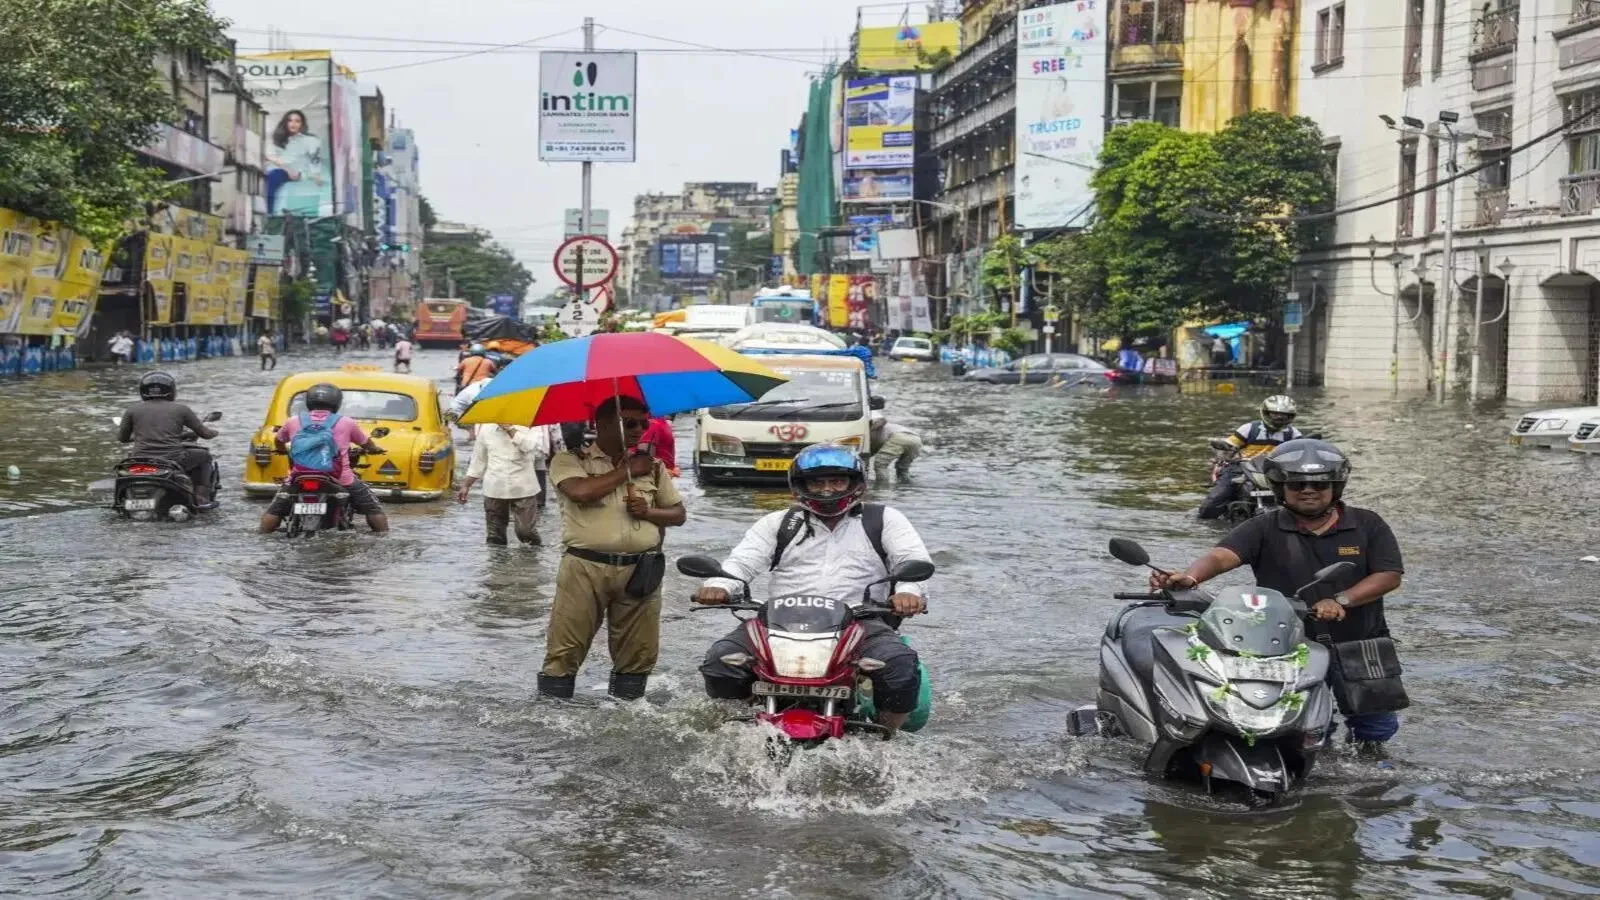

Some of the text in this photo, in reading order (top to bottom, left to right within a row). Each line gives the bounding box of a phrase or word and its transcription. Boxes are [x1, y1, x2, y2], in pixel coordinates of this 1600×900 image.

[1032, 58, 1065, 75] SREE
[542, 92, 629, 111] intim
[1028, 118, 1081, 134] TRUSTED
[774, 596, 836, 610] POLICE
